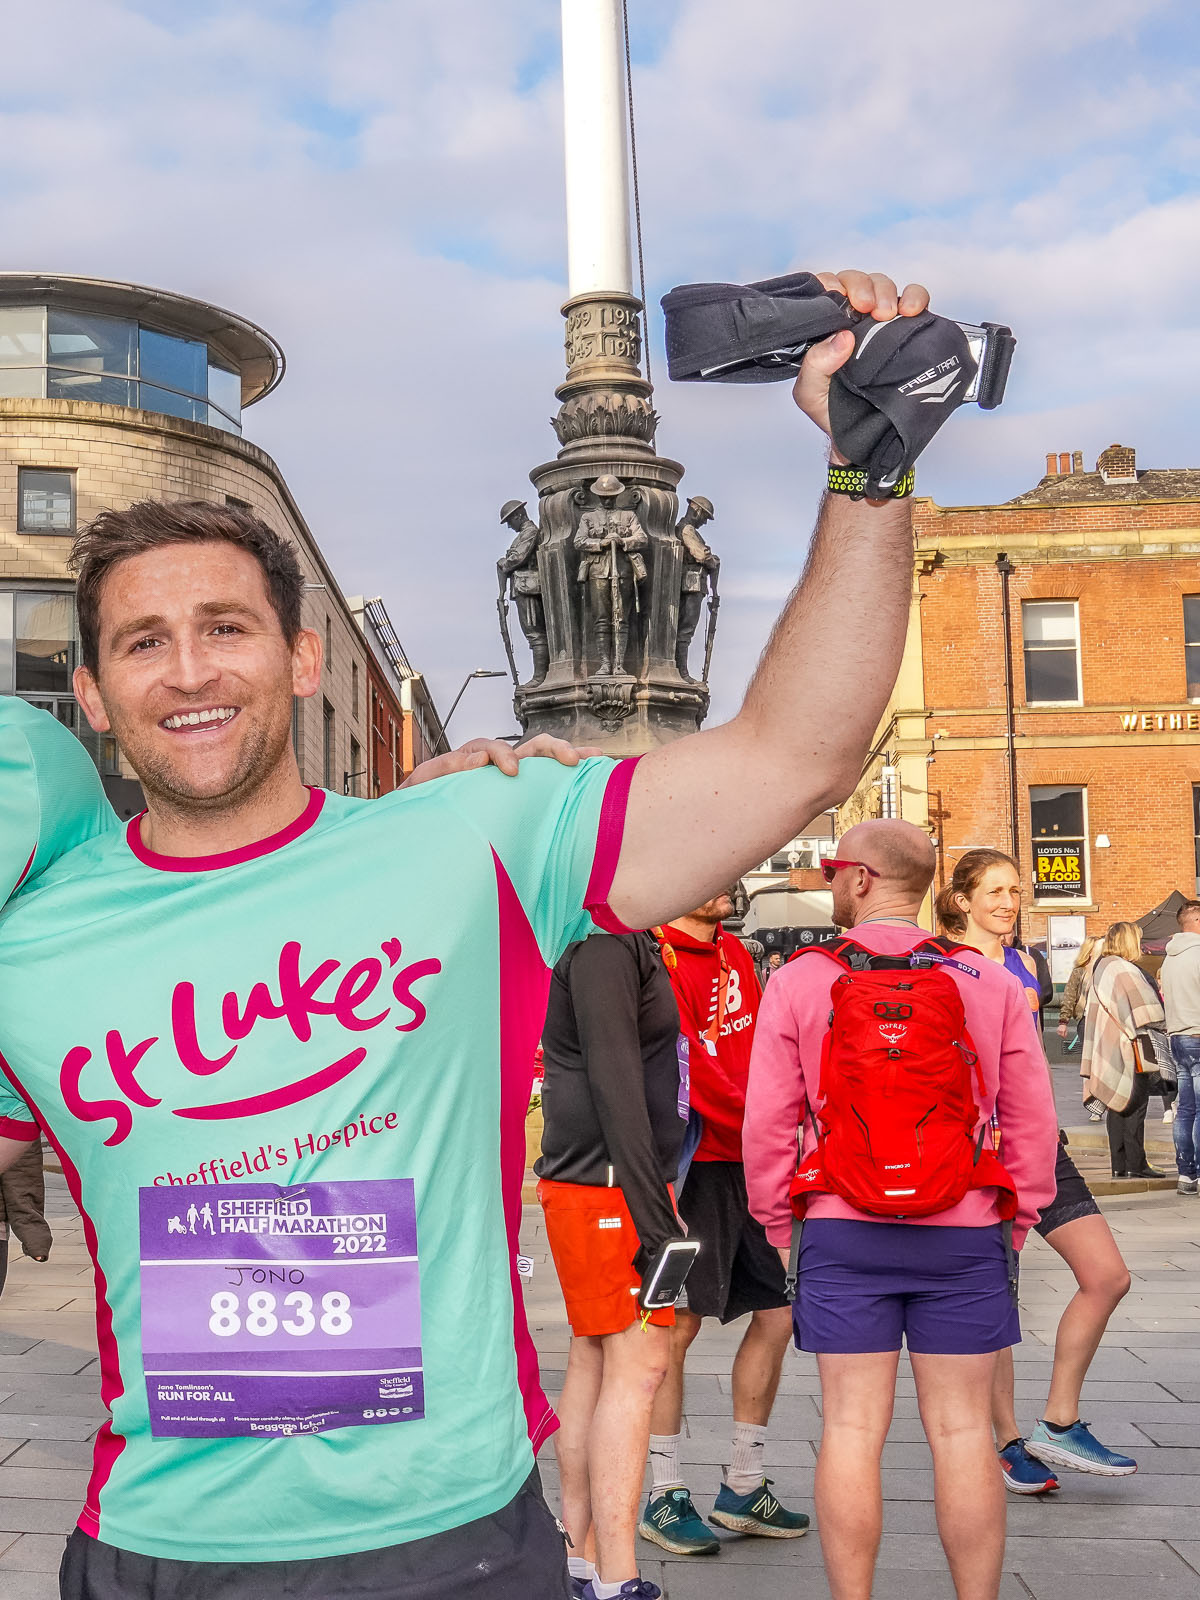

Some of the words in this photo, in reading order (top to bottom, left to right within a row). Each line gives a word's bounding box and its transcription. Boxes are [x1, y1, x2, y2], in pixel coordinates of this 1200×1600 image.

[898, 367, 937, 393] FREE
[1037, 856, 1080, 873] BAR
[1038, 873, 1047, 882] &
[1049, 872, 1080, 882] FOOD
[878, 1023, 908, 1031] OSPREY
[59, 1029, 163, 1147] St
[295, 1112, 399, 1159] Hospice
[220, 1200, 309, 1216] SHEFFIELD
[220, 1217, 269, 1234] HALF
[272, 1215, 384, 1234] MARATHON
[333, 1234, 387, 1254] 2022
[225, 1267, 305, 1286] JONO
[208, 1291, 353, 1337] 8838
[380, 1376, 411, 1385] Sheffield
[157, 1391, 185, 1401] RUN
[186, 1391, 211, 1401] FOR
[213, 1391, 236, 1402] ALL
